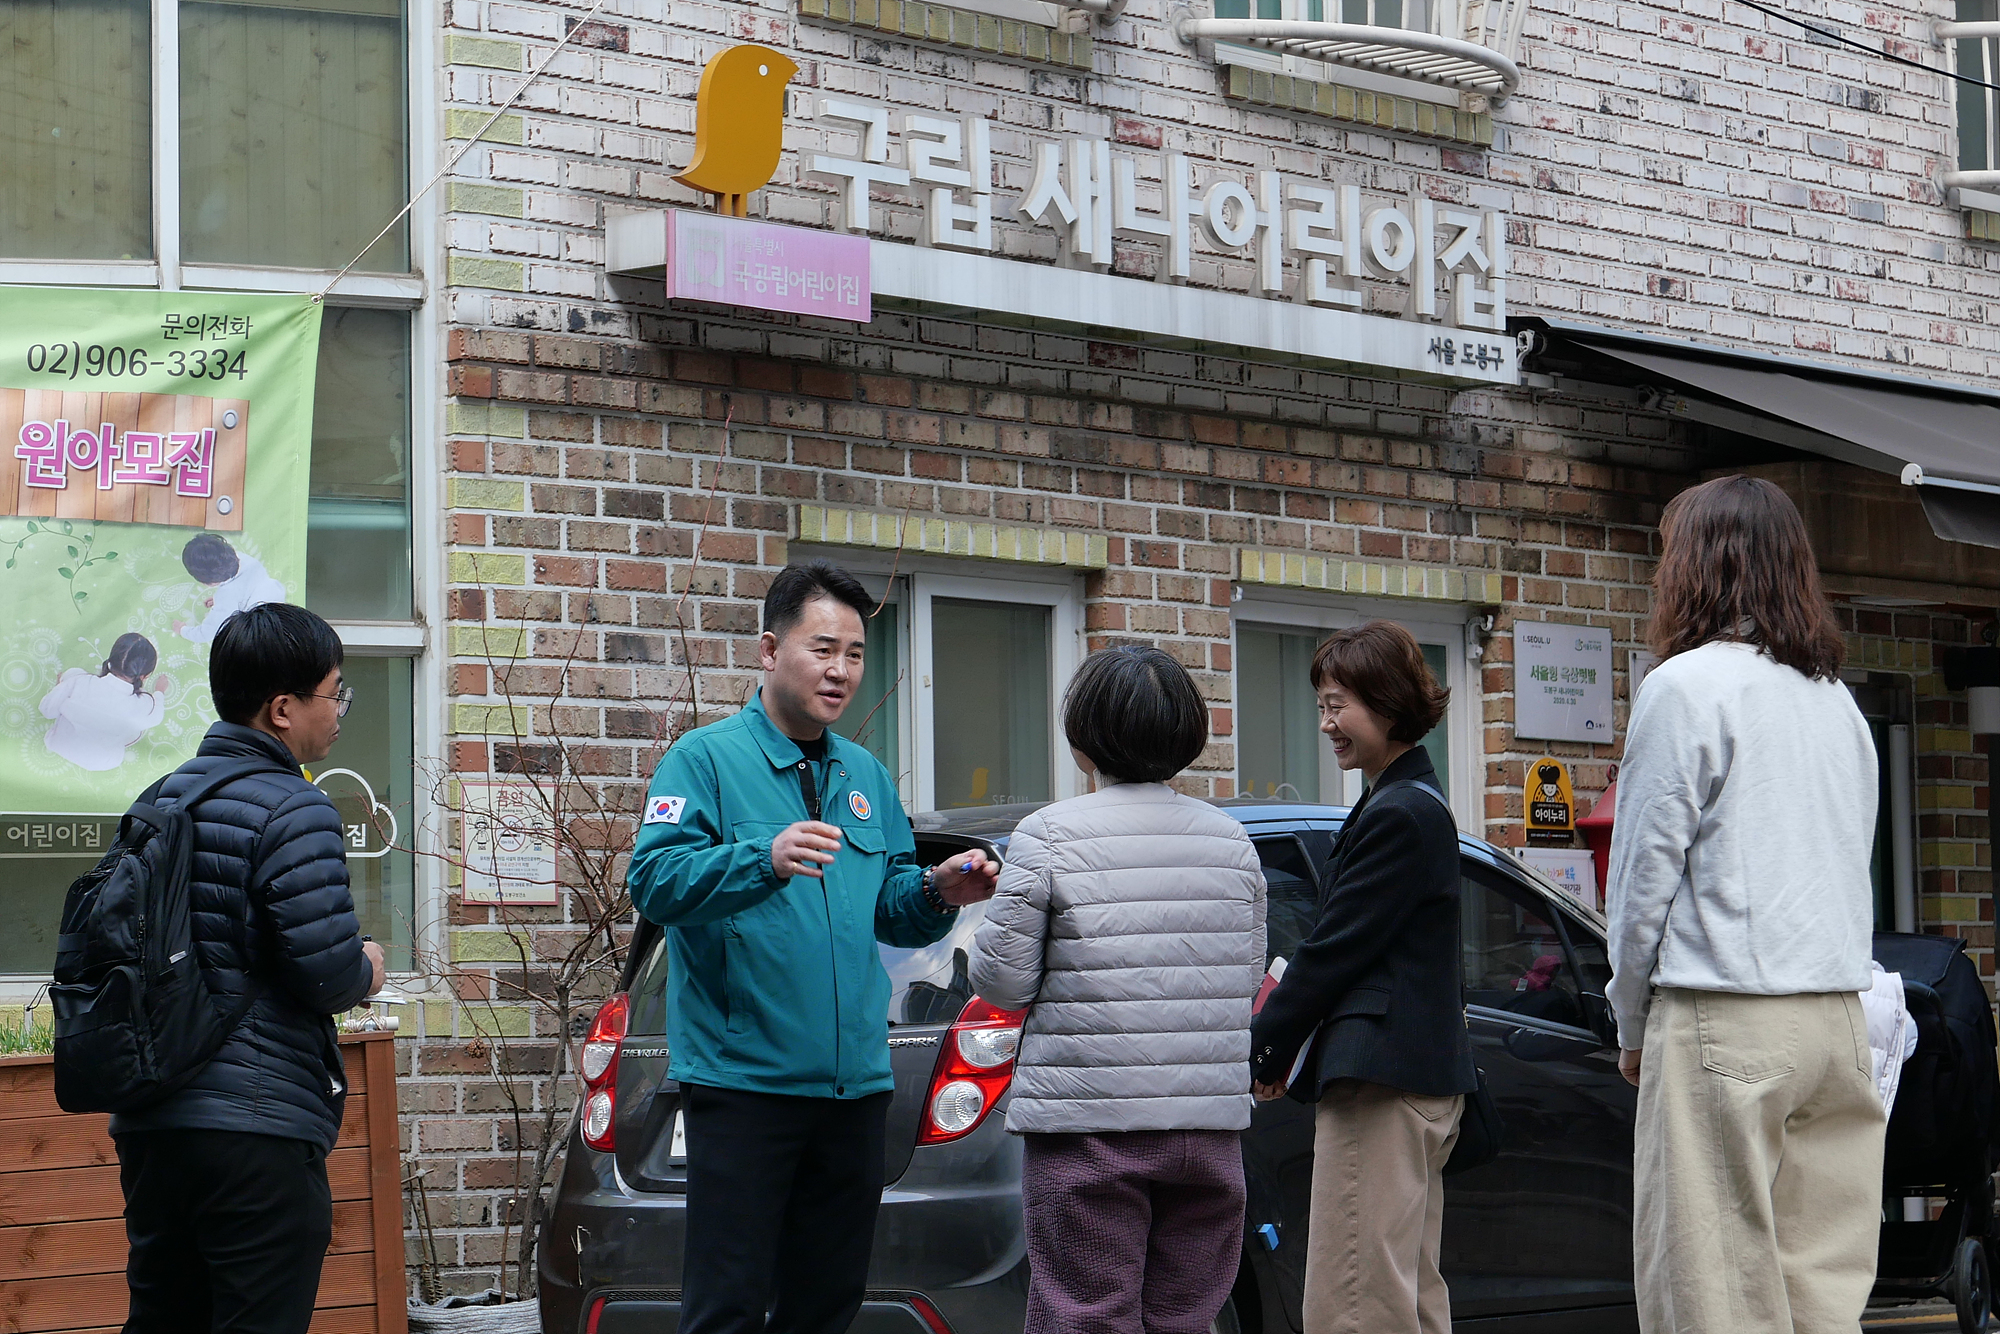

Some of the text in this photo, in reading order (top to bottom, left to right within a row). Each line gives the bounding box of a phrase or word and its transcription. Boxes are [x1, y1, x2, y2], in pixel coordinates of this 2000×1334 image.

[806, 98, 1507, 331] 구립 새나어린이집
[732, 260, 860, 306] 국공립어린이집
[160, 313, 254, 342] 문의전화
[26, 340, 249, 381] 02)906-3334
[1427, 336, 1505, 372] 서울 도봉구
[14, 418, 216, 498] 원아모집
[1530, 665, 1597, 684] 서울형 옥상텃밭
[1535, 808, 1566, 823] 아이누리
[6, 823, 101, 848] 어린이집
[887, 1036, 938, 1048] SPARK
